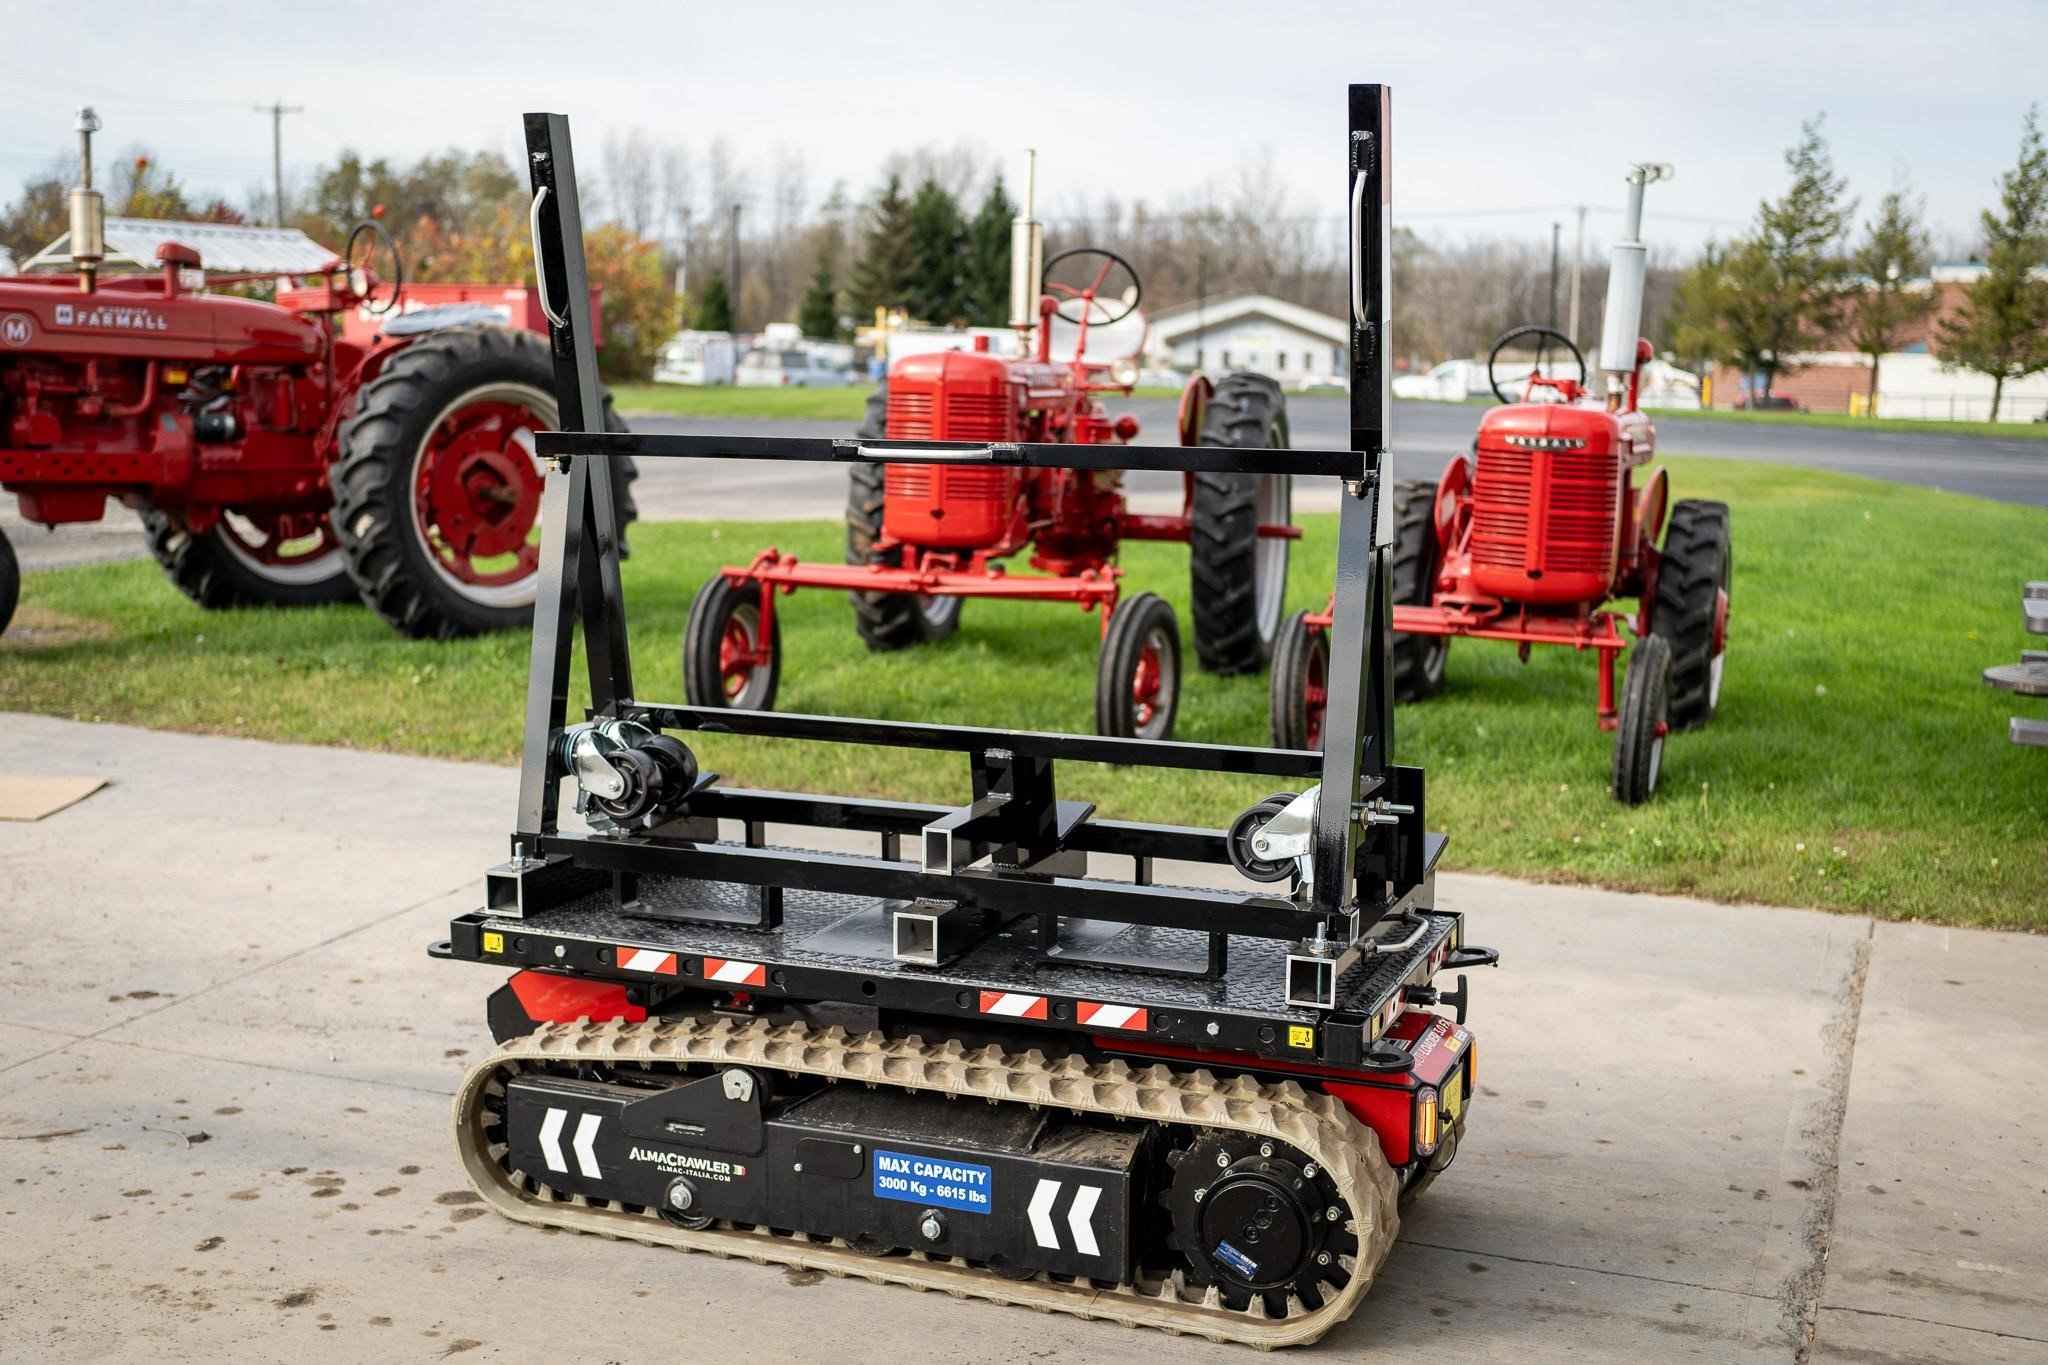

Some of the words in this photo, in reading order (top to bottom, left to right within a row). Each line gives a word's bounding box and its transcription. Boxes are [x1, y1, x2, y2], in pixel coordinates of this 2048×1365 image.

[77, 311, 168, 330] FARMALL
[6, 321, 26, 341] M
[657, 1165, 731, 1182] ALMAC-ITALIA.COM
[879, 1156, 910, 1173] MAX
[913, 1162, 986, 1185] CAPACITY
[879, 1176, 907, 1191] 3000
[910, 1181, 927, 1197] Kg
[936, 1185, 966, 1201] 6615
[969, 1190, 987, 1204] lbs
